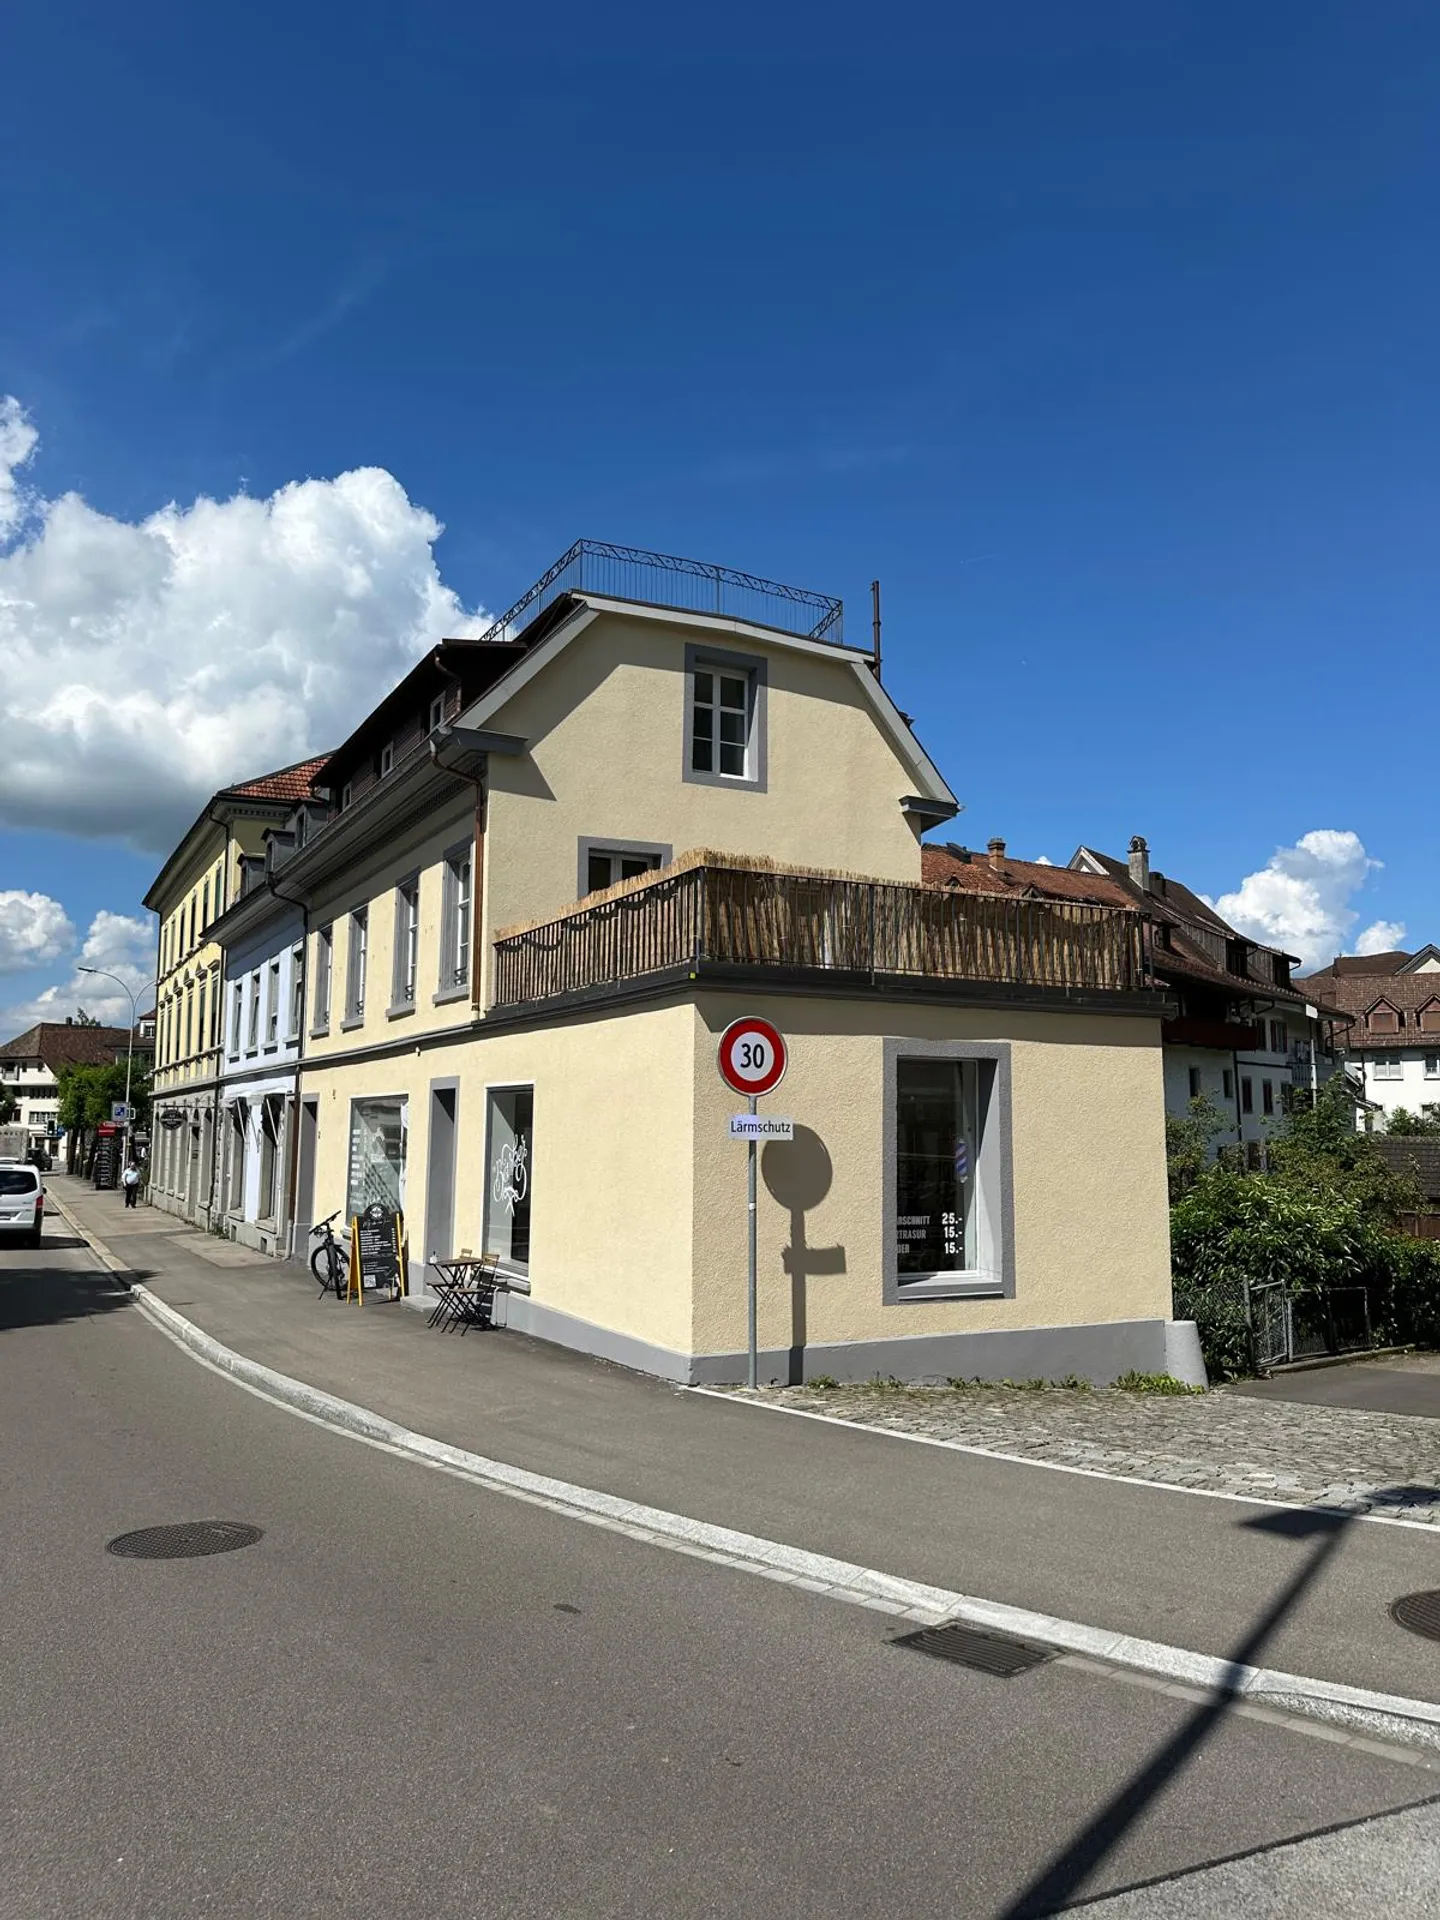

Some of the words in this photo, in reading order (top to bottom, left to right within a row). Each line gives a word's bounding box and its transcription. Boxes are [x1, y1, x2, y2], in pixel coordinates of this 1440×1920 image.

[740, 1043, 765, 1069] 30
[731, 1121, 791, 1133] Lärmschutz
[896, 1215, 930, 1225] RSCHNITT
[942, 1212, 963, 1225] 25.-
[944, 1226, 963, 1238] 15.-
[896, 1243, 909, 1253] DER
[945, 1241, 963, 1254] 15.-
